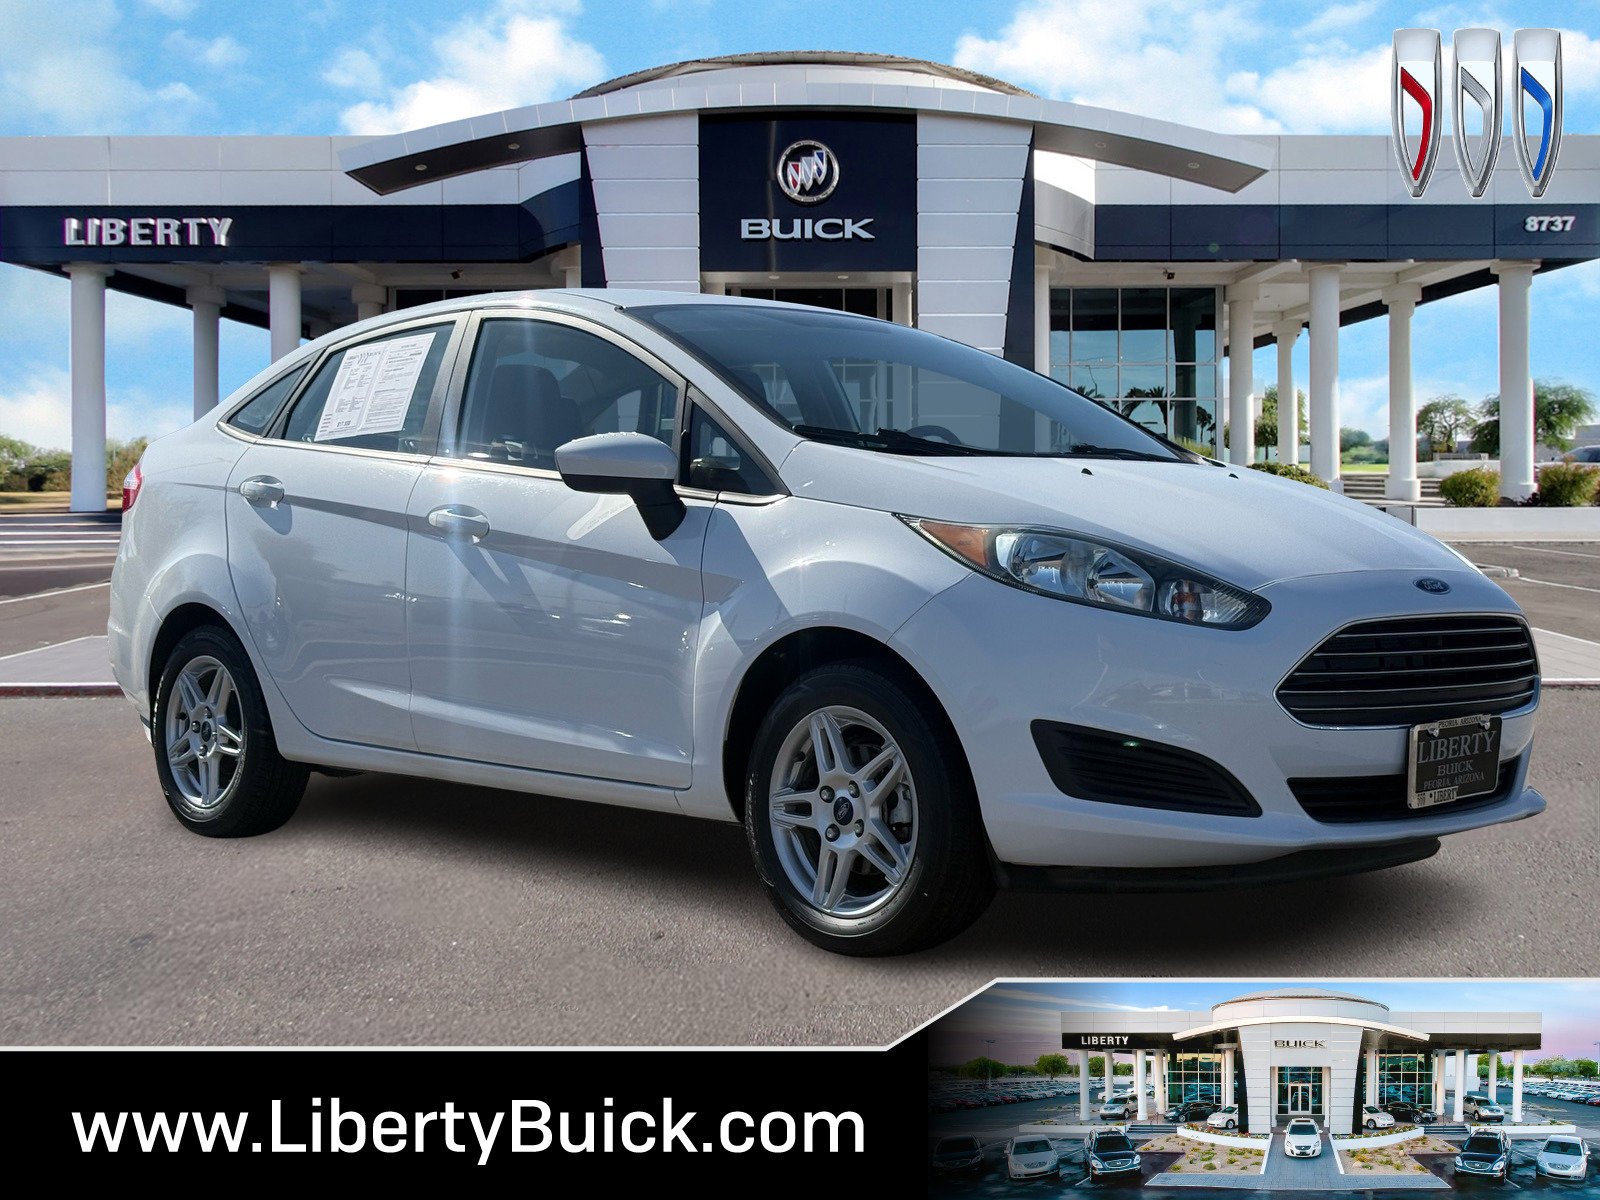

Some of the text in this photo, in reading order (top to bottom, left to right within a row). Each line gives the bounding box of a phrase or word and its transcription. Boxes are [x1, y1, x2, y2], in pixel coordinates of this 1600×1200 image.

[64, 217, 233, 247] LIBERTY
[740, 218, 875, 240] BUICK
[1524, 215, 1575, 232] 8737
[1418, 730, 1497, 763] LIBERTY
[1437, 760, 1474, 776] BUICK
[1454, 771, 1485, 785] ARIZONA
